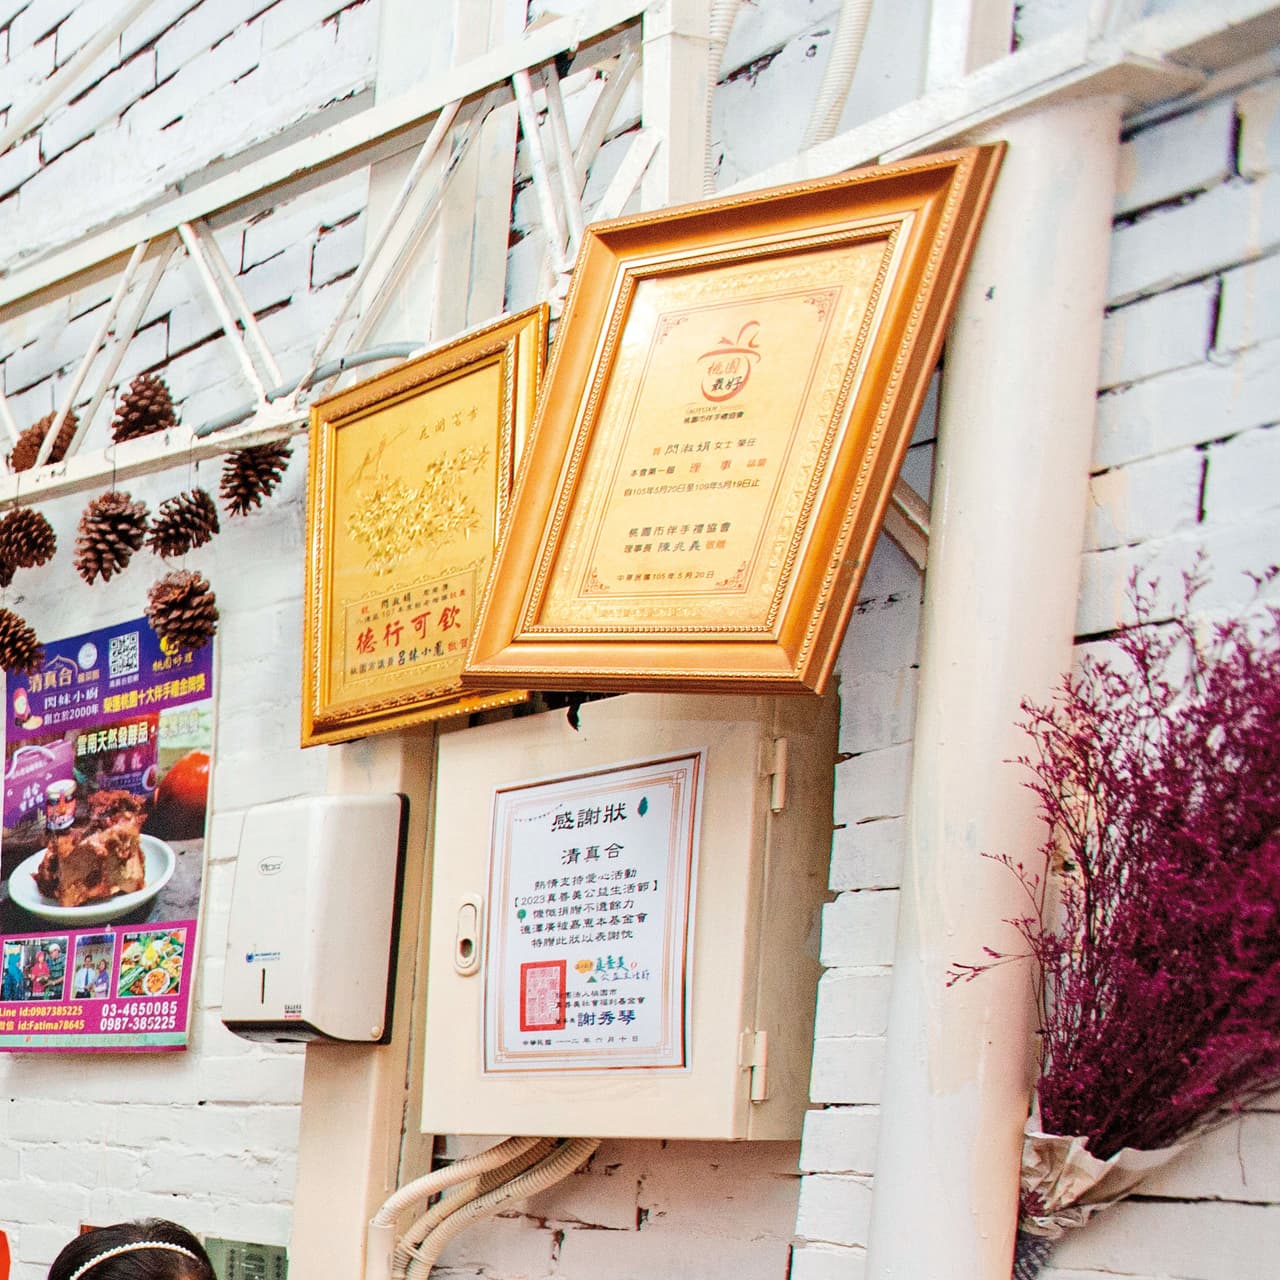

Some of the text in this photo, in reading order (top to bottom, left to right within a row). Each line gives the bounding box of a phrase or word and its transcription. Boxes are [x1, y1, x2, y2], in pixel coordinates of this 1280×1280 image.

[551, 803, 627, 832] 感謝狀
[561, 842, 625, 865] 清真合
[534, 868, 637, 891] 熱情支持愛心活動
[532, 899, 635, 919] 慷慨捐贈不遺餘力
[19, 1005, 83, 1017] id:0987385225
[101, 1001, 178, 1017] 03-4650085
[577, 1009, 637, 1027] 謝秀琴
[18, 1019, 85, 1031] id:Fatima78645
[100, 1016, 176, 1032] 0987-385225
